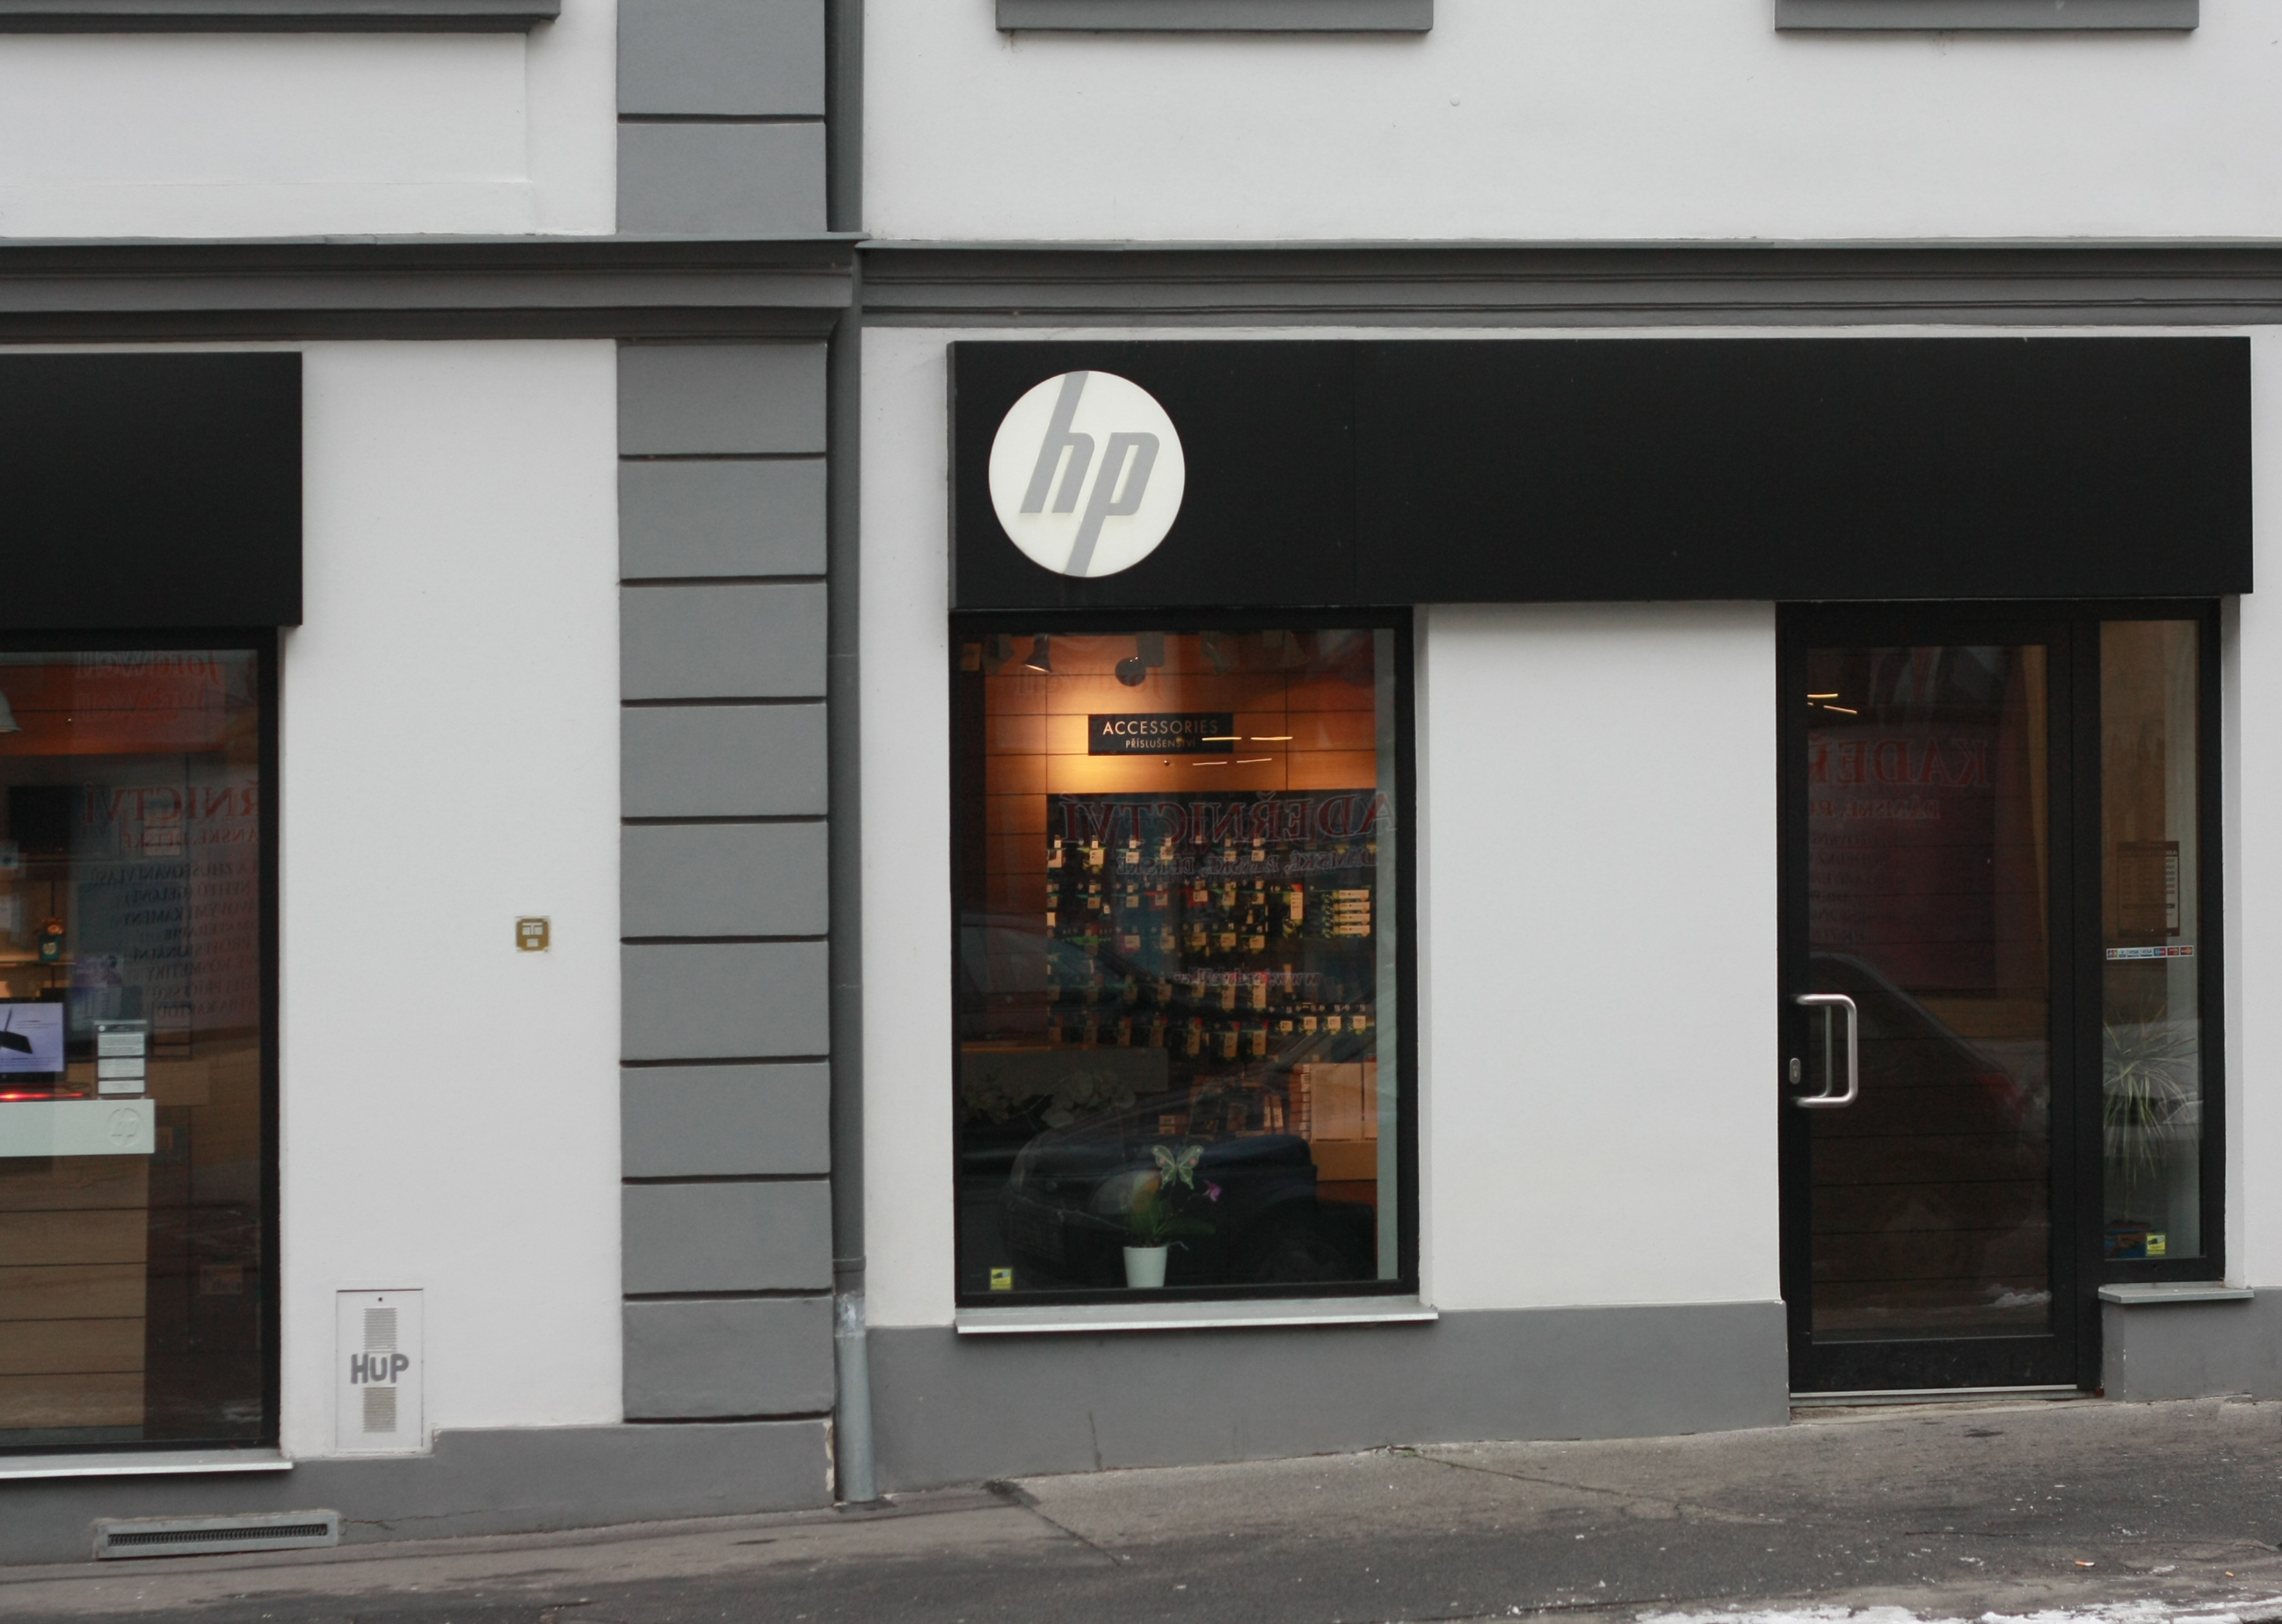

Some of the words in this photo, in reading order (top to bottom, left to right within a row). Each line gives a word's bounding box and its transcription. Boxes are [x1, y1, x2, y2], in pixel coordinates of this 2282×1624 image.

[1020, 370, 1159, 577] hp
[1102, 720, 1219, 736] ACCESSORIES
[351, 1353, 410, 1384] HUP
